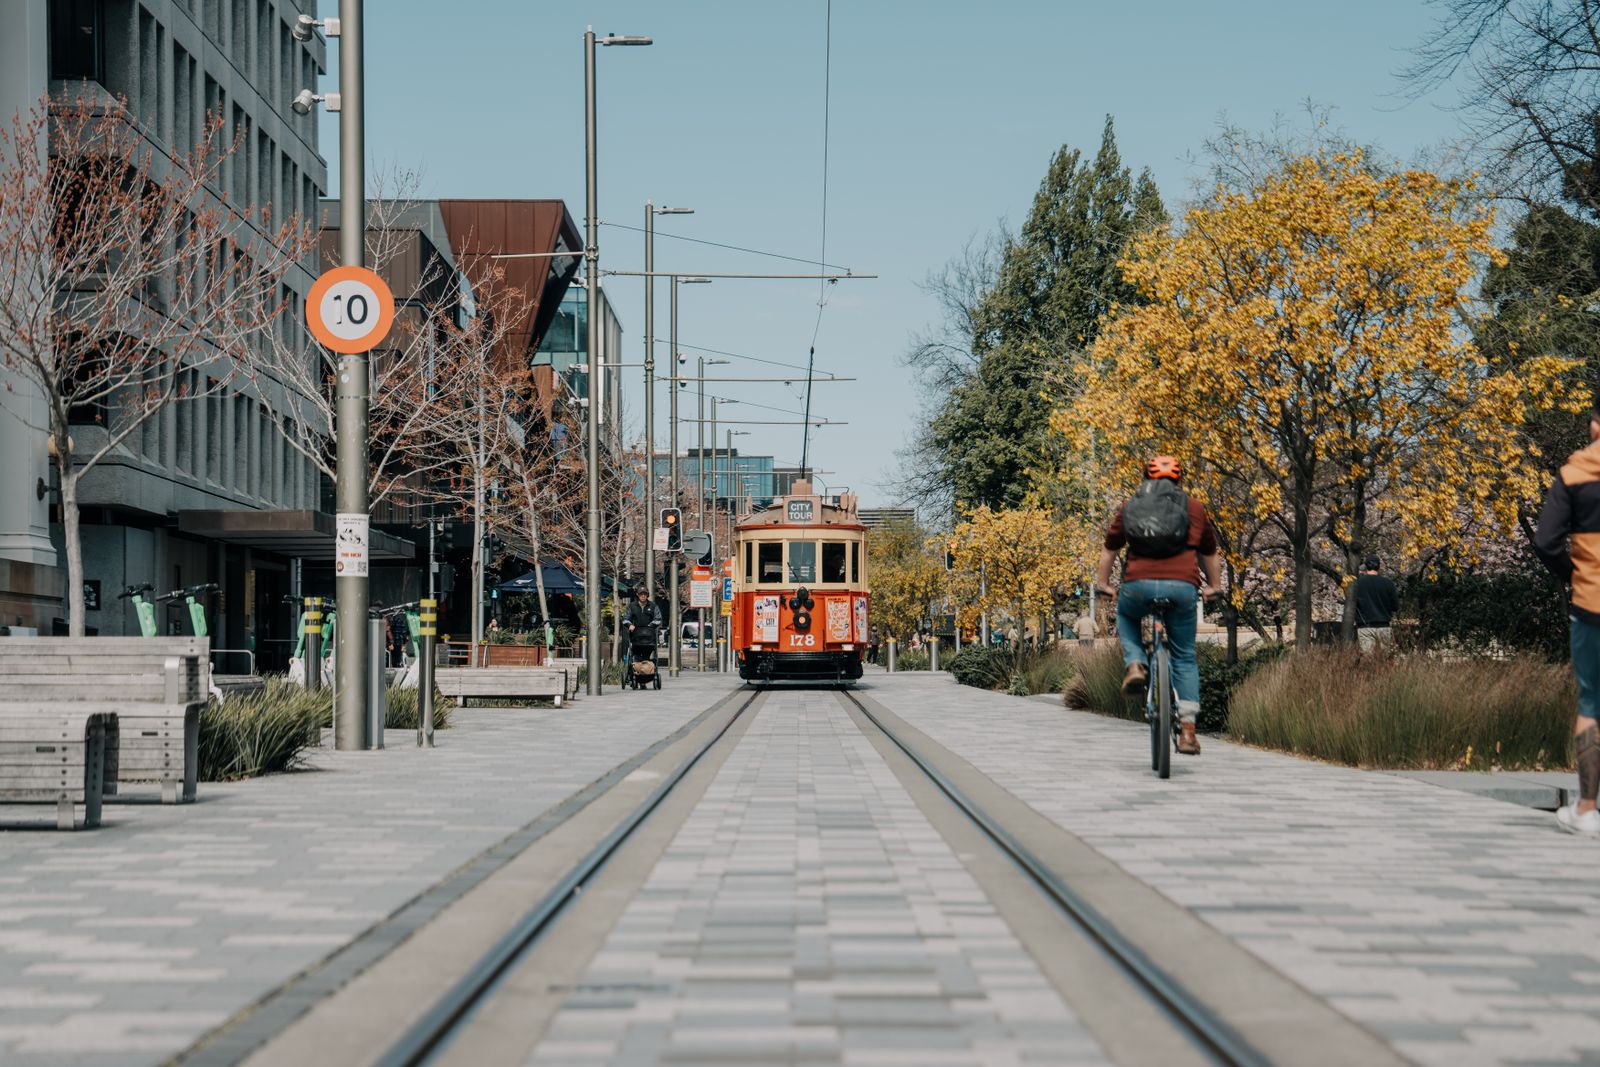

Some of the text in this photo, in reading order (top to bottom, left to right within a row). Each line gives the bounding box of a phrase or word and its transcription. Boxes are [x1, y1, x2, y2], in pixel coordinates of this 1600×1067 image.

[790, 503, 810, 511] CITY
[789, 512, 813, 520] TOUR
[790, 634, 815, 647] 178
